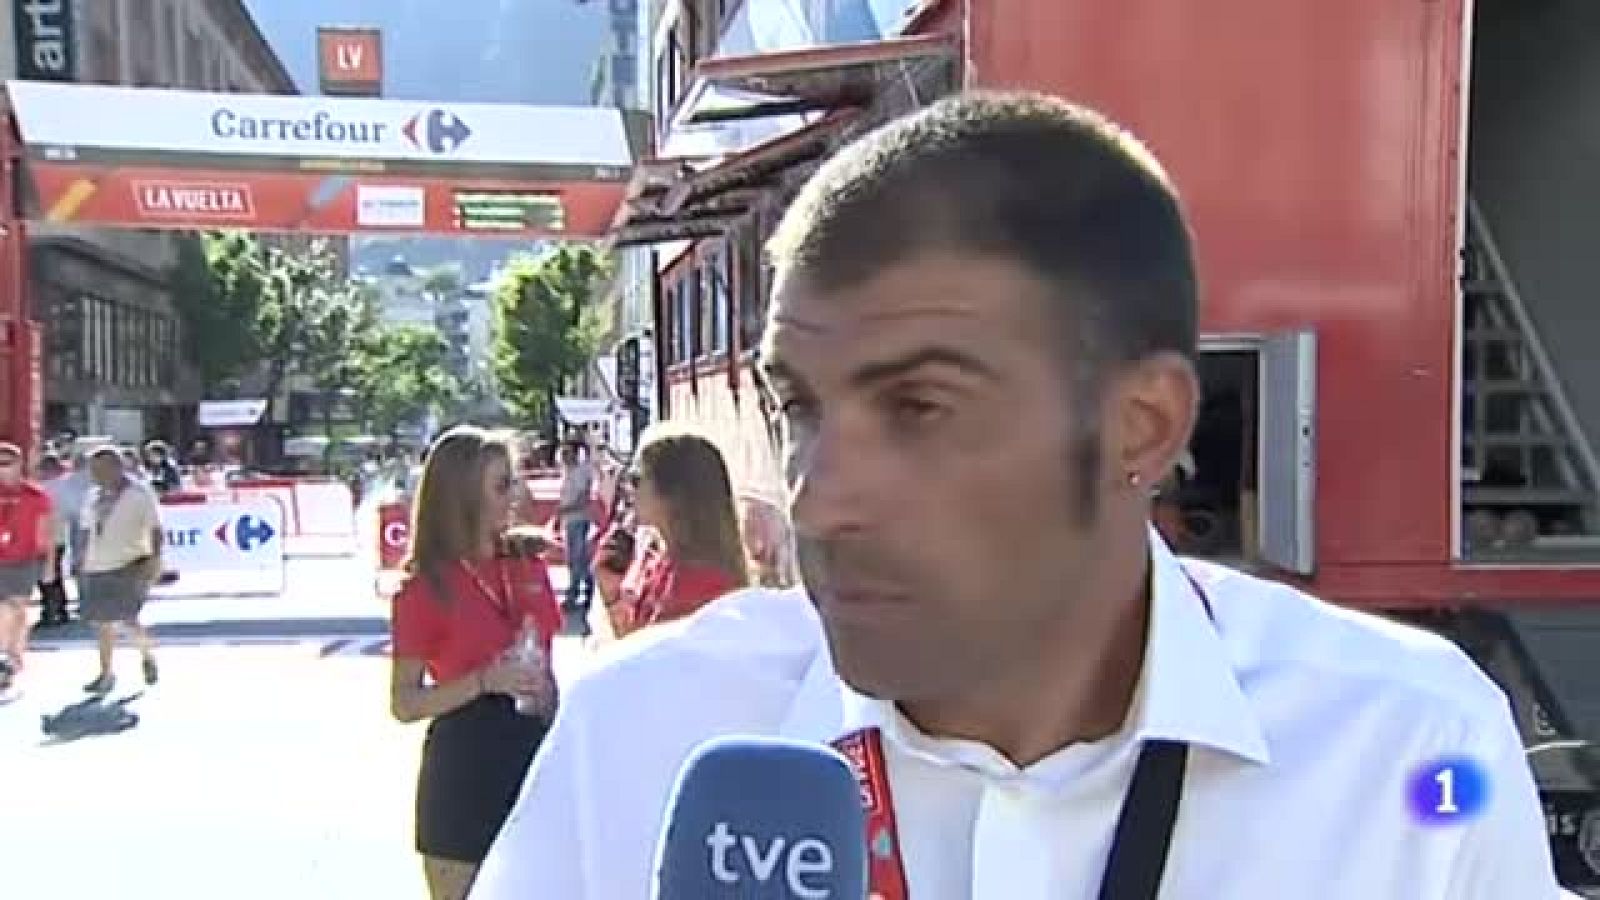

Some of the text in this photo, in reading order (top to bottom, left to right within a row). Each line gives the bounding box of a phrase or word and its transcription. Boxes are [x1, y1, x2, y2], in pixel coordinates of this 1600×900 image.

[336, 44, 362, 69] LV
[211, 107, 387, 143] Carrefour
[144, 186, 244, 212] LA VUELTA
[706, 821, 834, 899] tve
